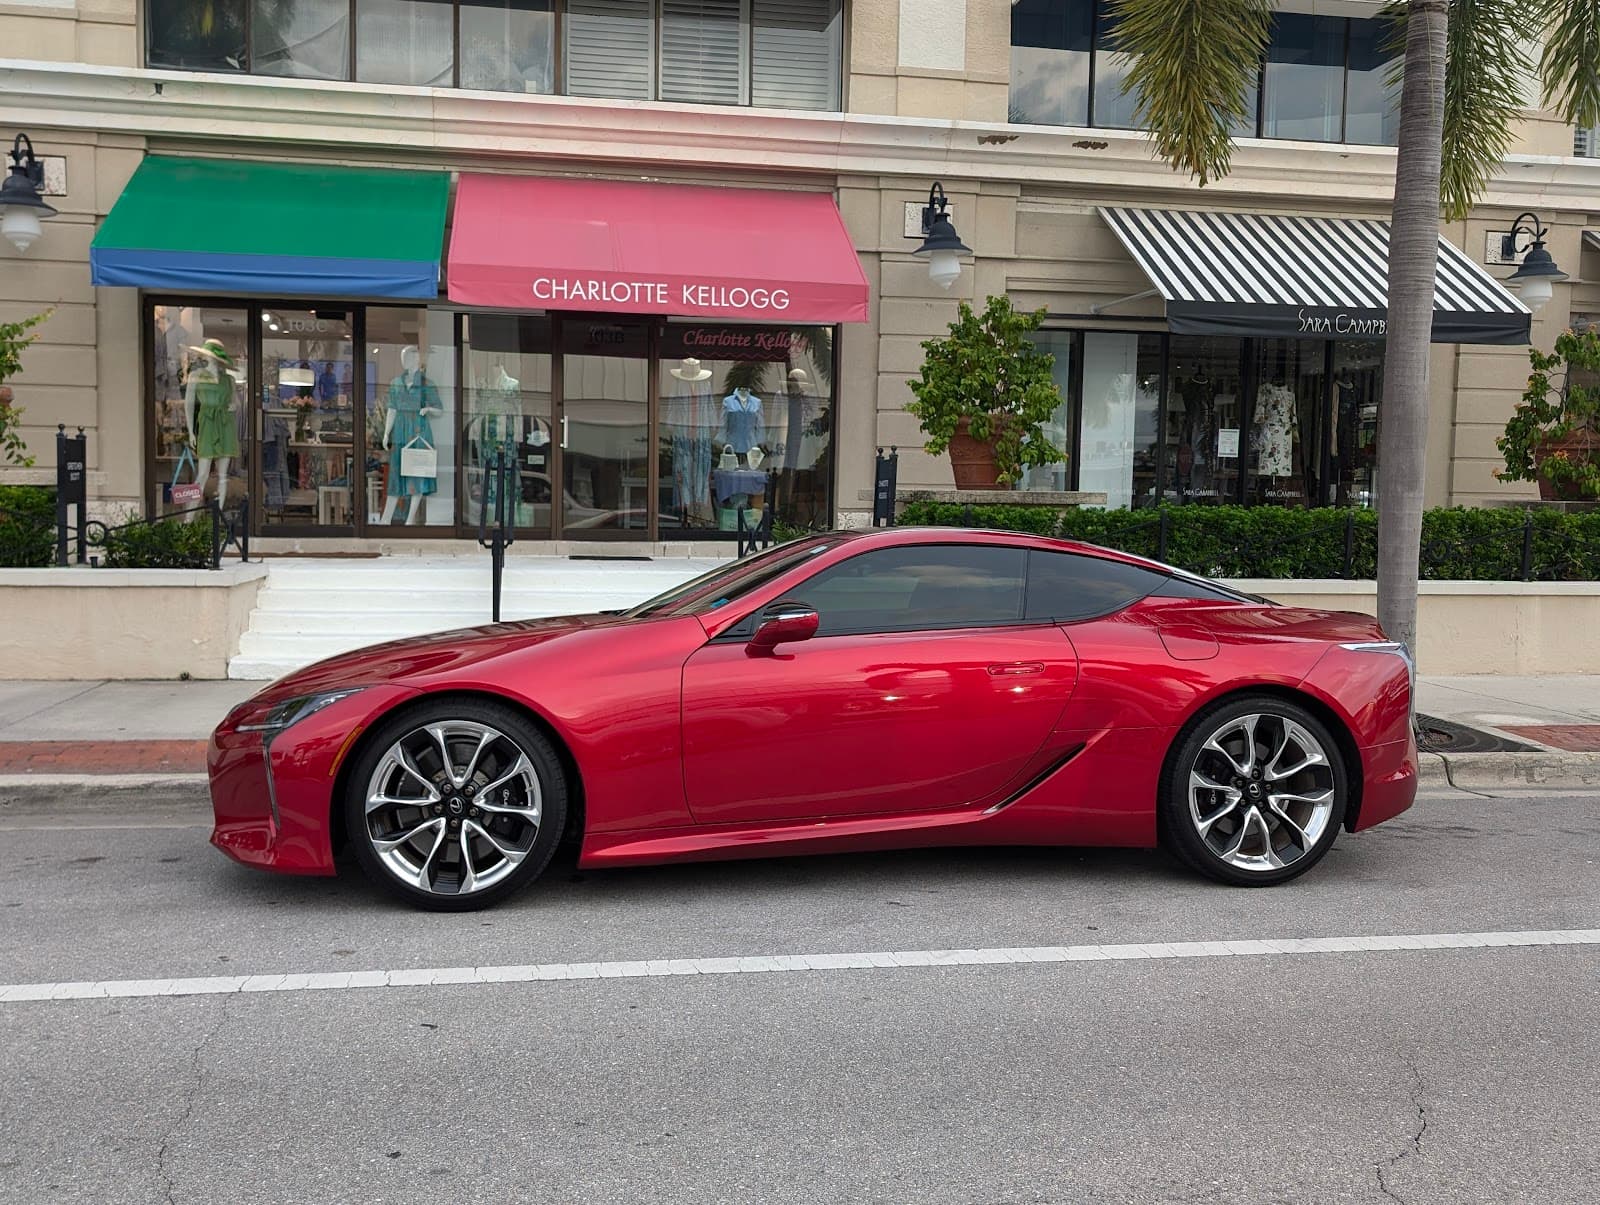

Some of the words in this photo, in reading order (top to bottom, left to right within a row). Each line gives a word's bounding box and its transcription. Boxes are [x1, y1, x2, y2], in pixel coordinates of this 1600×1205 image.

[532, 278, 668, 304] CHARLOTTE
[682, 284, 790, 310] KELLOGG
[1298, 308, 1332, 334] SARA
[1335, 313, 1388, 335] CAMPB
[683, 328, 751, 347] Charlotte
[174, 489, 200, 498] CLOSED
